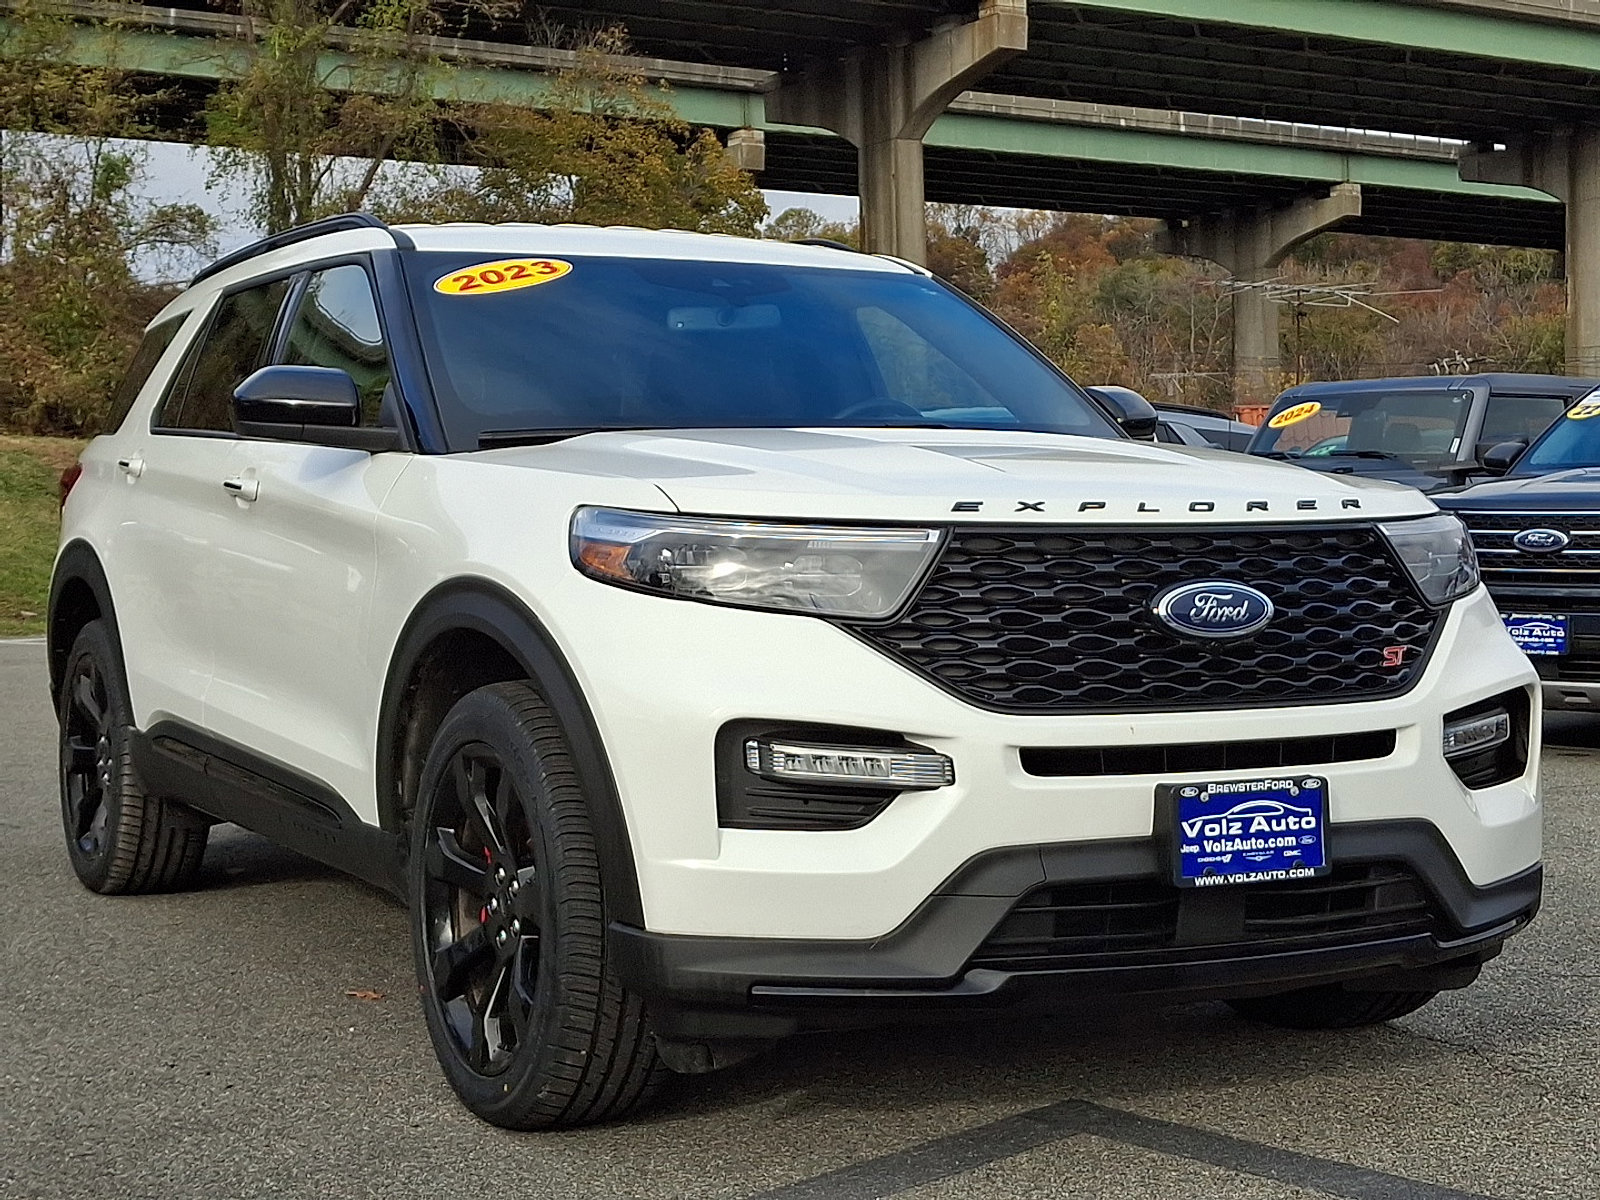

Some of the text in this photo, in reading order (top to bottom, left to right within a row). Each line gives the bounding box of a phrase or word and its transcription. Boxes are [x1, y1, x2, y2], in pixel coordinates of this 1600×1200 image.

[452, 261, 558, 291] 2023
[1274, 403, 1316, 425] 2024
[950, 498, 1362, 513] EXPLORER
[1189, 592, 1250, 623] Ford
[1531, 628, 1565, 637] Auto
[1383, 646, 1407, 667] ST
[1181, 815, 1316, 838] Volz Auto
[1180, 844, 1200, 854] Jeep
[1203, 836, 1297, 853] VolzAuto.com
[1194, 867, 1315, 887] WWW.VOLZAUTO.COM
